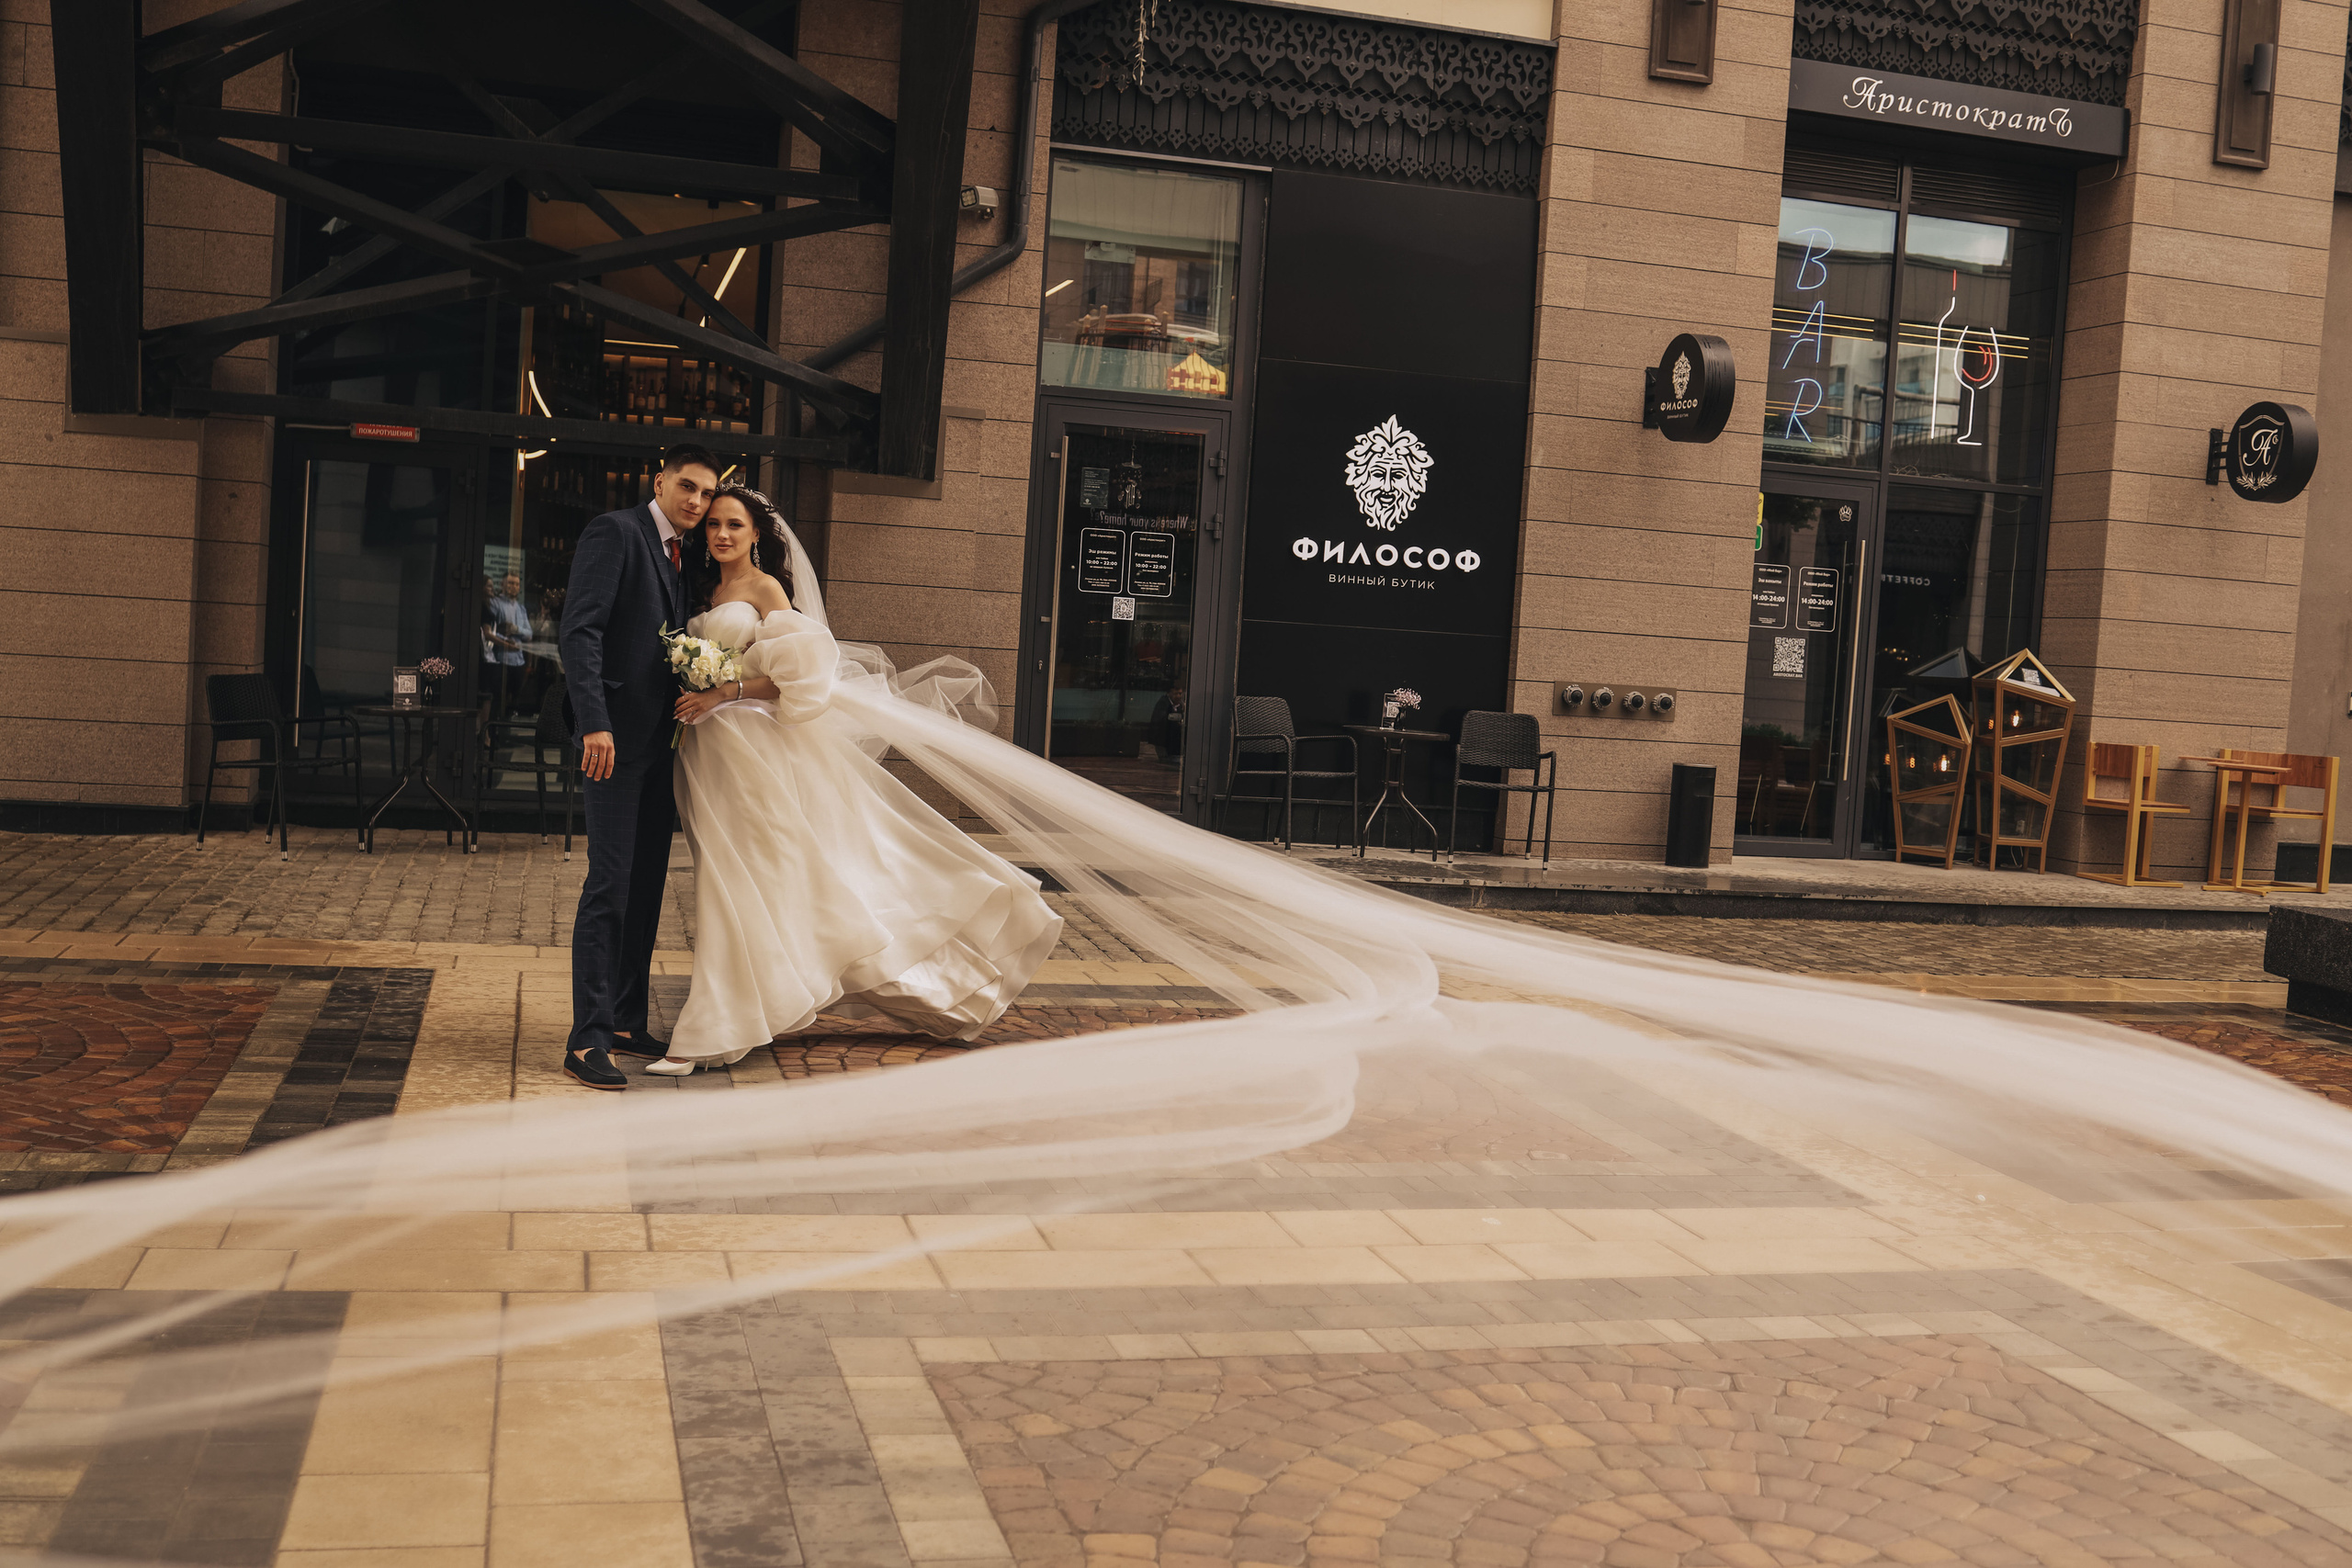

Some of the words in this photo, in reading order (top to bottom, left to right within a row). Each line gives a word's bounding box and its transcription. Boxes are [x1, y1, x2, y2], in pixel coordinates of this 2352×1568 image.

[1660, 399, 1698, 411] ФИЛОСОФ
[358, 427, 413, 437] ПОЖАРОТУШЕНИЯ
[1293, 536, 1481, 572] ФИЛОСОФ
[1329, 573, 1385, 586] ВИННЫЙ
[1391, 578, 1435, 590] БУТИК
